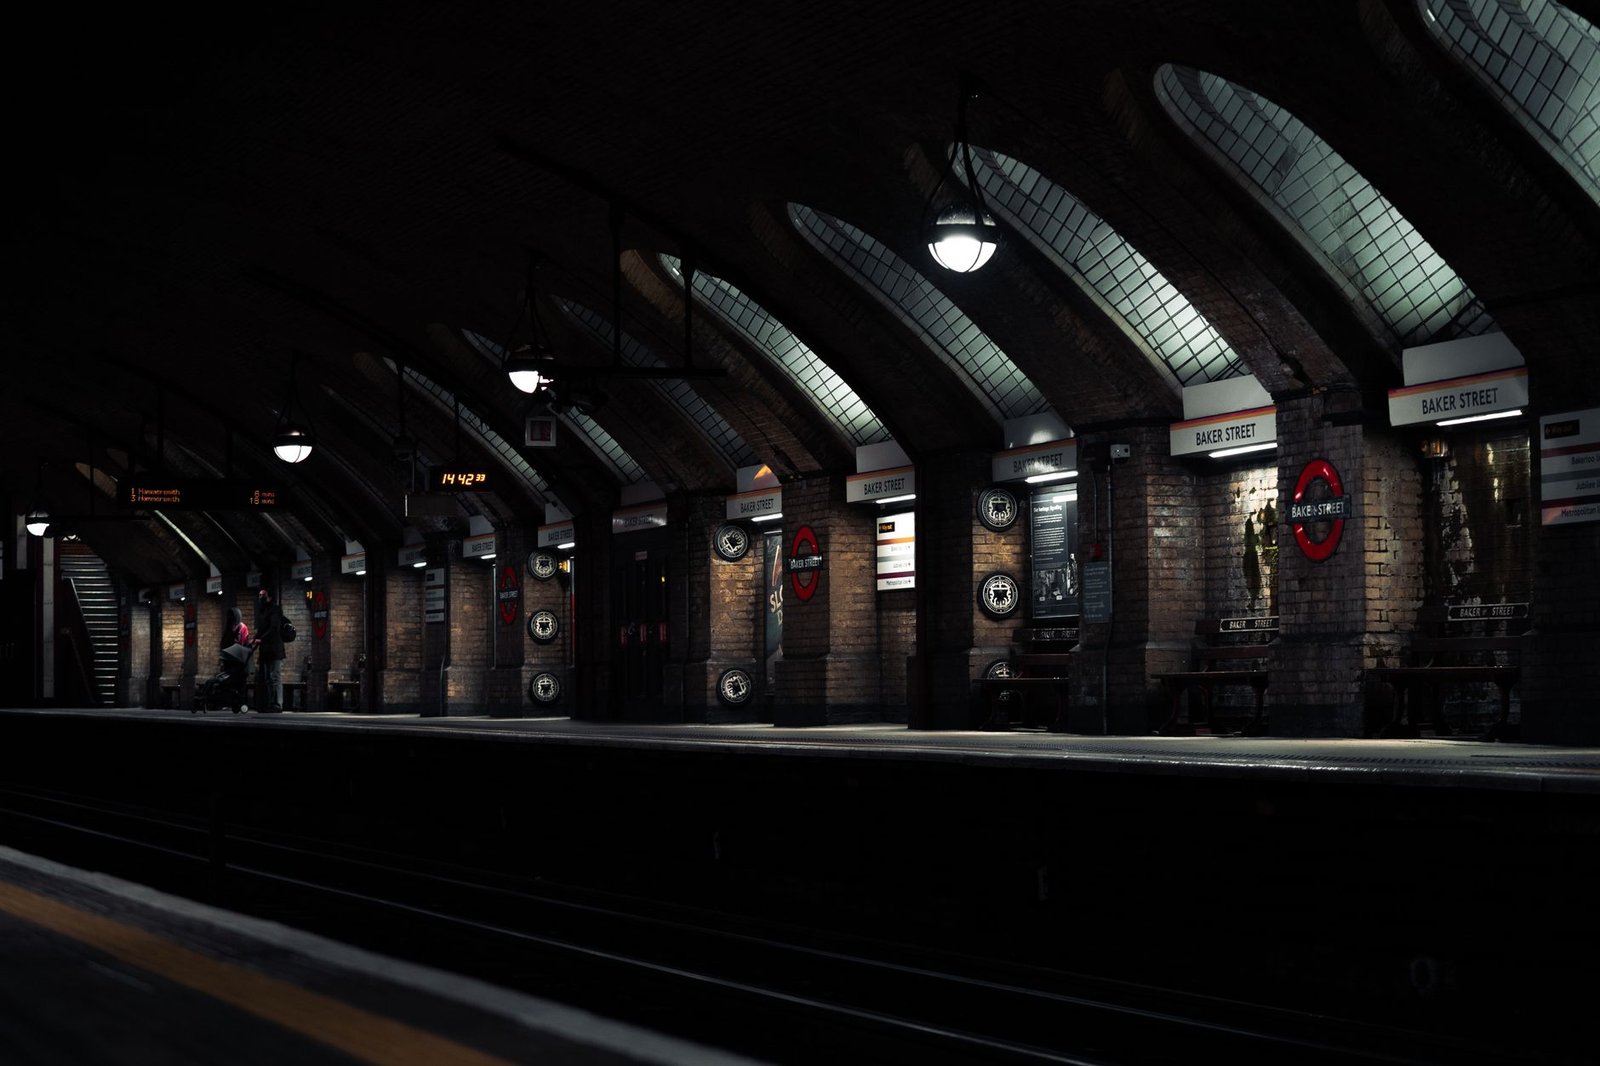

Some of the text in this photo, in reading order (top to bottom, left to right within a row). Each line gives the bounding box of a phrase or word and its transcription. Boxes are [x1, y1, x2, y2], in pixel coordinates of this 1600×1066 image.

[1422, 388, 1498, 415] BAKER STREET
[1196, 423, 1256, 446] BAKER STREET
[1013, 453, 1063, 473] BAKER STREET
[442, 473, 456, 485] 14
[458, 473, 474, 486] 42
[864, 478, 905, 495] BAKER STREET
[741, 498, 774, 514] BAKER STREET
[1291, 501, 1344, 518] BAKER STREET
[790, 558, 804, 570] BAKER
[1460, 606, 1515, 618] BAKER STREET
[1254, 619, 1273, 628] STREET
